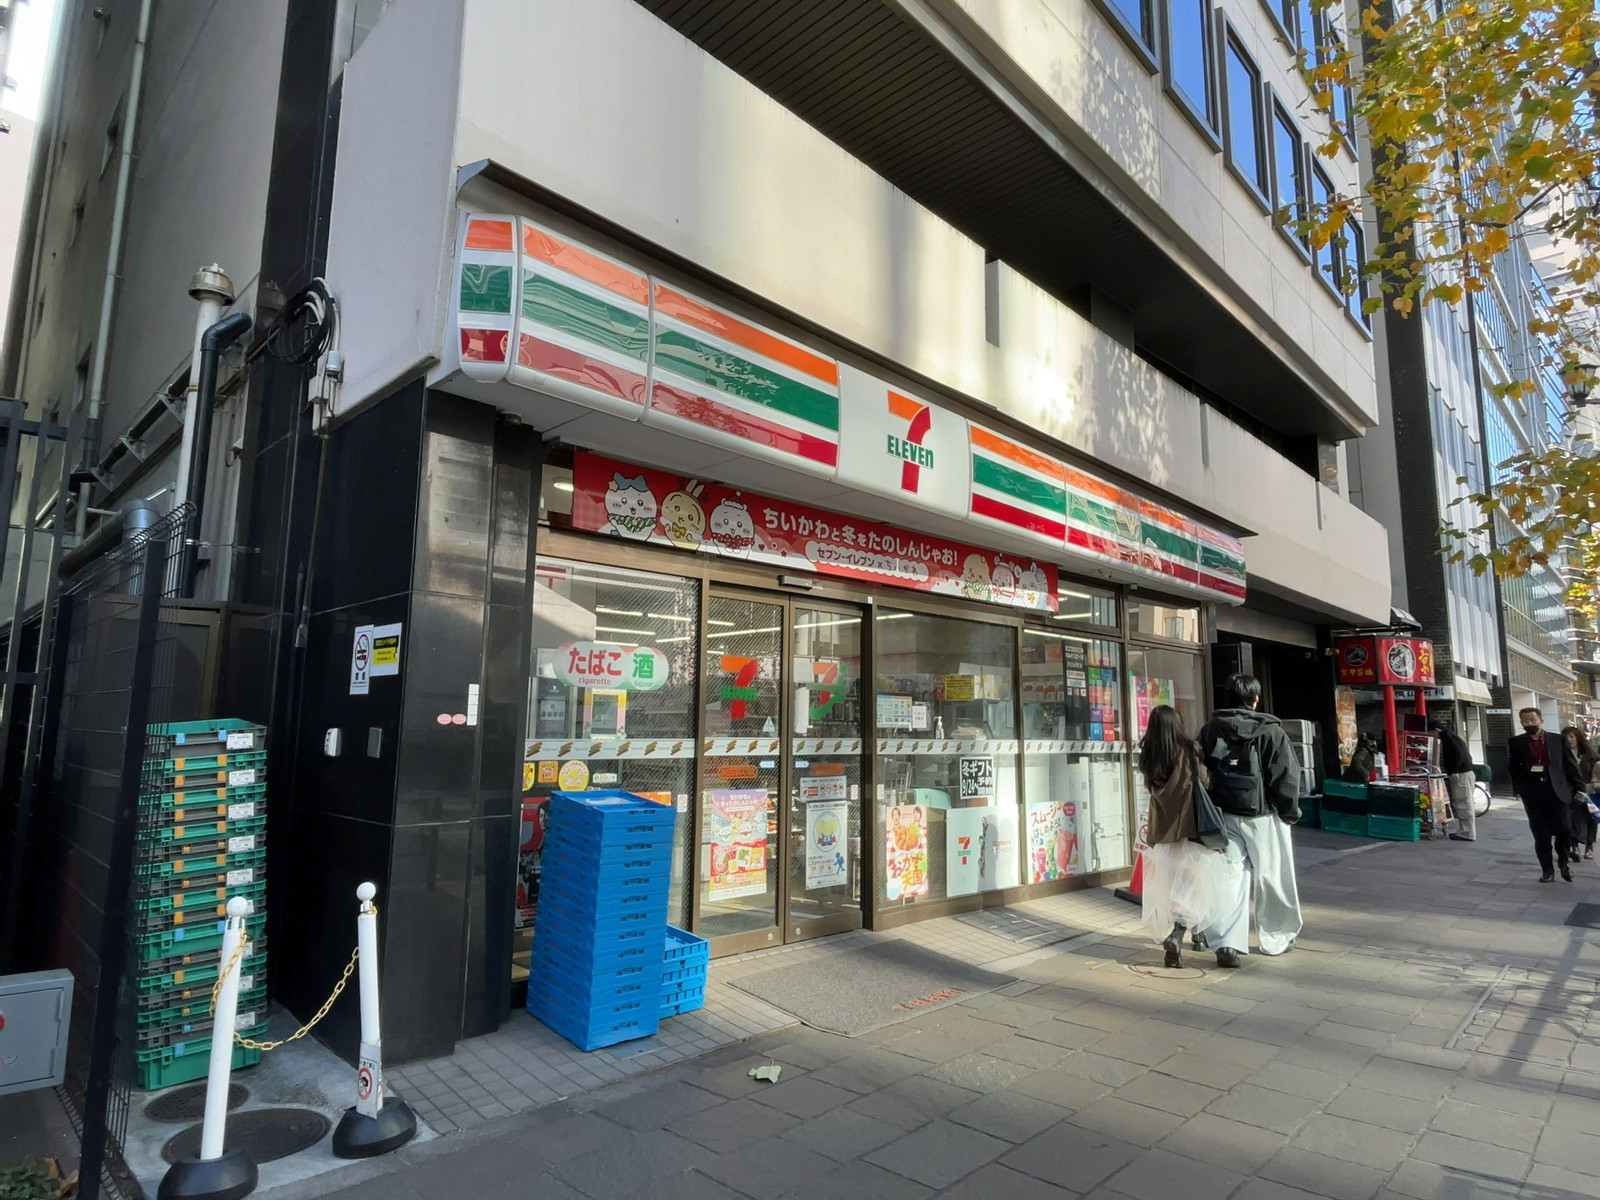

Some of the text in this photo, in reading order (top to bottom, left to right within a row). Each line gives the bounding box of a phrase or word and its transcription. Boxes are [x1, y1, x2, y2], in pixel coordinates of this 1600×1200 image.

[568, 647, 655, 679] たばこ 酒
[962, 760, 993, 777] 冬ギフト
